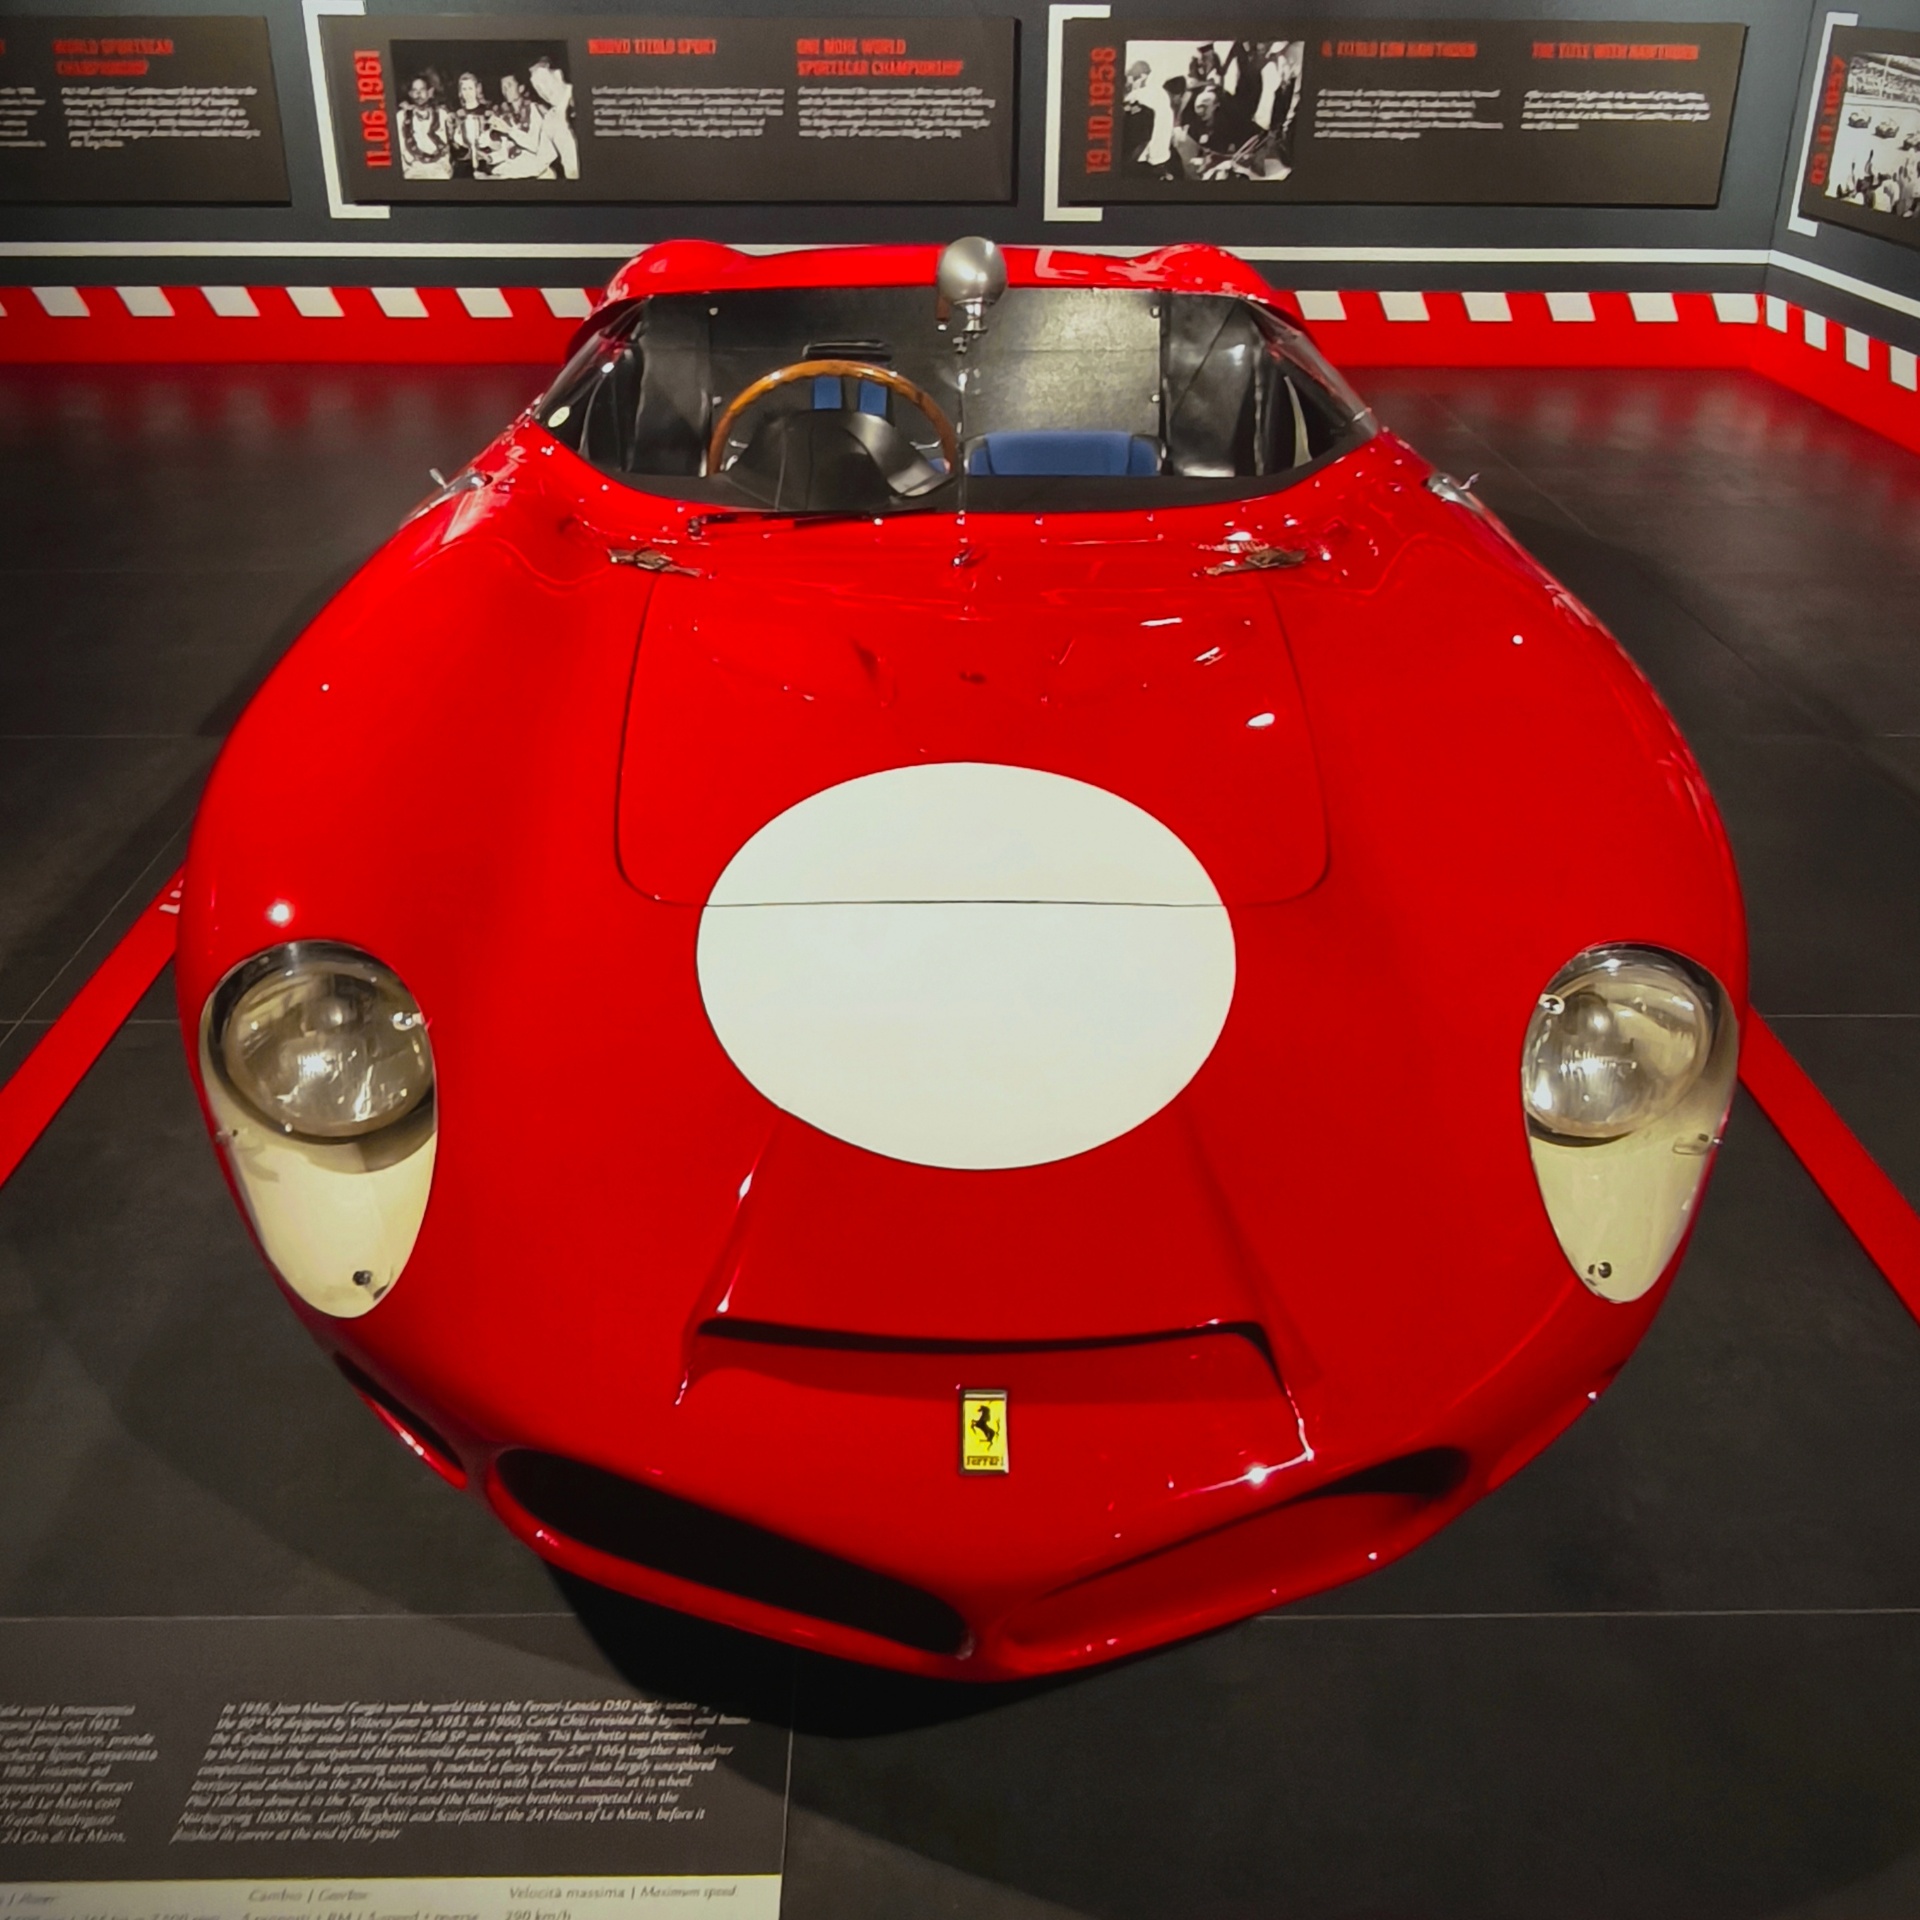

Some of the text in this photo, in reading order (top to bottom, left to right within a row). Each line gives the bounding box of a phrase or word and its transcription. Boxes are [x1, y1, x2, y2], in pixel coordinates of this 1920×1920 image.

[354, 50, 393, 168] 11.06.1961
[1086, 47, 1116, 175] 19.10.1958
[966, 1455, 1005, 1467] Ferrari
[410, 1702, 430, 1713] the
[430, 1701, 464, 1713] world
[488, 1701, 502, 1713] in
[501, 1701, 521, 1713] the
[603, 1700, 632, 1712] D50
[333, 1716, 348, 1731] by
[472, 1716, 487, 1727] In
[489, 1715, 524, 1730] 1960,
[526, 1715, 559, 1727] Carlo
[638, 1715, 658, 1726] the
[345, 1732, 359, 1744] in
[359, 1732, 380, 1744] the
[381, 1732, 420, 1744] Ferrari
[482, 1732, 502, 1743] the
[546, 1731, 572, 1743] This
[628, 1733, 651, 1742] was
[650, 1731, 706, 1745] presented
[218, 1748, 240, 1759] the
[284, 1747, 305, 1759] the
[360, 1747, 375, 1761] of
[374, 1747, 395, 1758] the
[454, 1746, 496, 1761] factory
[495, 1748, 513, 1758] on
[514, 1746, 566, 1760] February
[628, 1745, 676, 1759] together
[676, 1745, 702, 1756] with
[311, 1763, 332, 1775] the
[431, 1762, 444, 1773] It
[443, 1762, 491, 1773] marked
[489, 1763, 500, 1773] a
[531, 1761, 548, 1775] by
[548, 1761, 588, 1772] Ferrari
[89, 1780, 134, 1793] Ferrari
[315, 1779, 329, 1790] in
[329, 1778, 351, 1790] the
[350, 1778, 371, 1790] 24
[370, 1778, 409, 1790] Hours
[408, 1778, 424, 1792] of
[423, 1778, 439, 1789] Le
[438, 1778, 475, 1789] Mans
[502, 1777, 532, 1789] with
[531, 1777, 579, 1788] Lorenzo
[626, 1776, 641, 1788] at
[641, 1776, 658, 1788] its
[55, 1797, 93, 1809] Mans
[325, 1794, 347, 1806] the
[346, 1794, 382, 1808] Targa
[418, 1793, 445, 1805] and
[443, 1793, 465, 1805] the
[525, 1793, 576, 1804] brothers
[633, 1792, 645, 1804] it
[645, 1792, 659, 1804] in
[659, 1792, 681, 1803] the
[409, 1810, 435, 1822] and
[488, 1809, 504, 1821] in
[503, 1809, 525, 1821] the
[526, 1809, 546, 1821] 24
[546, 1809, 585, 1820] Hours
[585, 1809, 601, 1823] of
[600, 1808, 616, 1820] Le
[617, 1808, 653, 1823] Mans,
[656, 1808, 695, 1822] before
[695, 1808, 707, 1819] it
[274, 1828, 292, 1840] at
[289, 1828, 313, 1840] the
[311, 1828, 338, 1840] end
[336, 1828, 354, 1843] of
[351, 1828, 373, 1840] the
[510, 1885, 562, 1899] Velocità
[566, 1887, 625, 1899] massima
